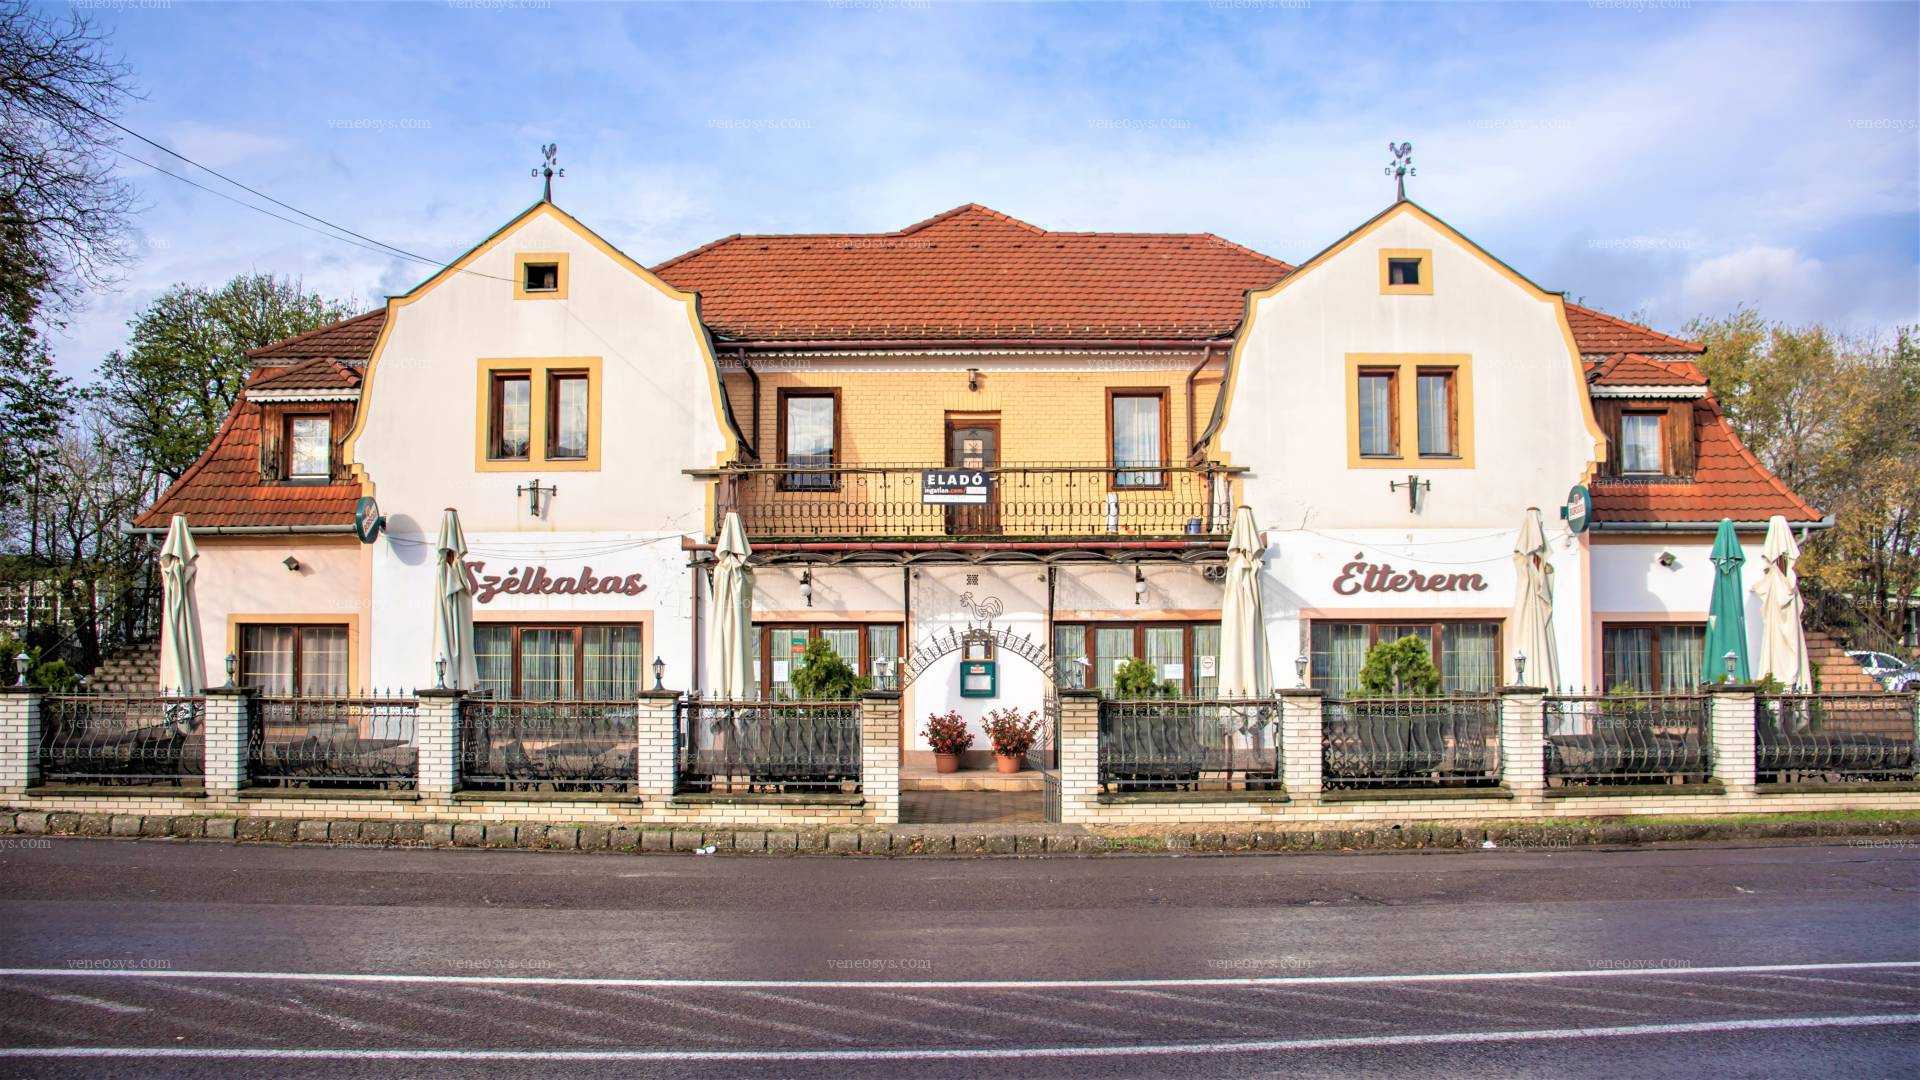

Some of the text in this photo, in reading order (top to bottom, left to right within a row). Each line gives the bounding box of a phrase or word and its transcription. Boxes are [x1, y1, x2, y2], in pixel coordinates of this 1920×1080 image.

[928, 472, 983, 486] ELADÓ
[463, 561, 648, 604] Szélkakas
[1332, 551, 1489, 596] Étterem
